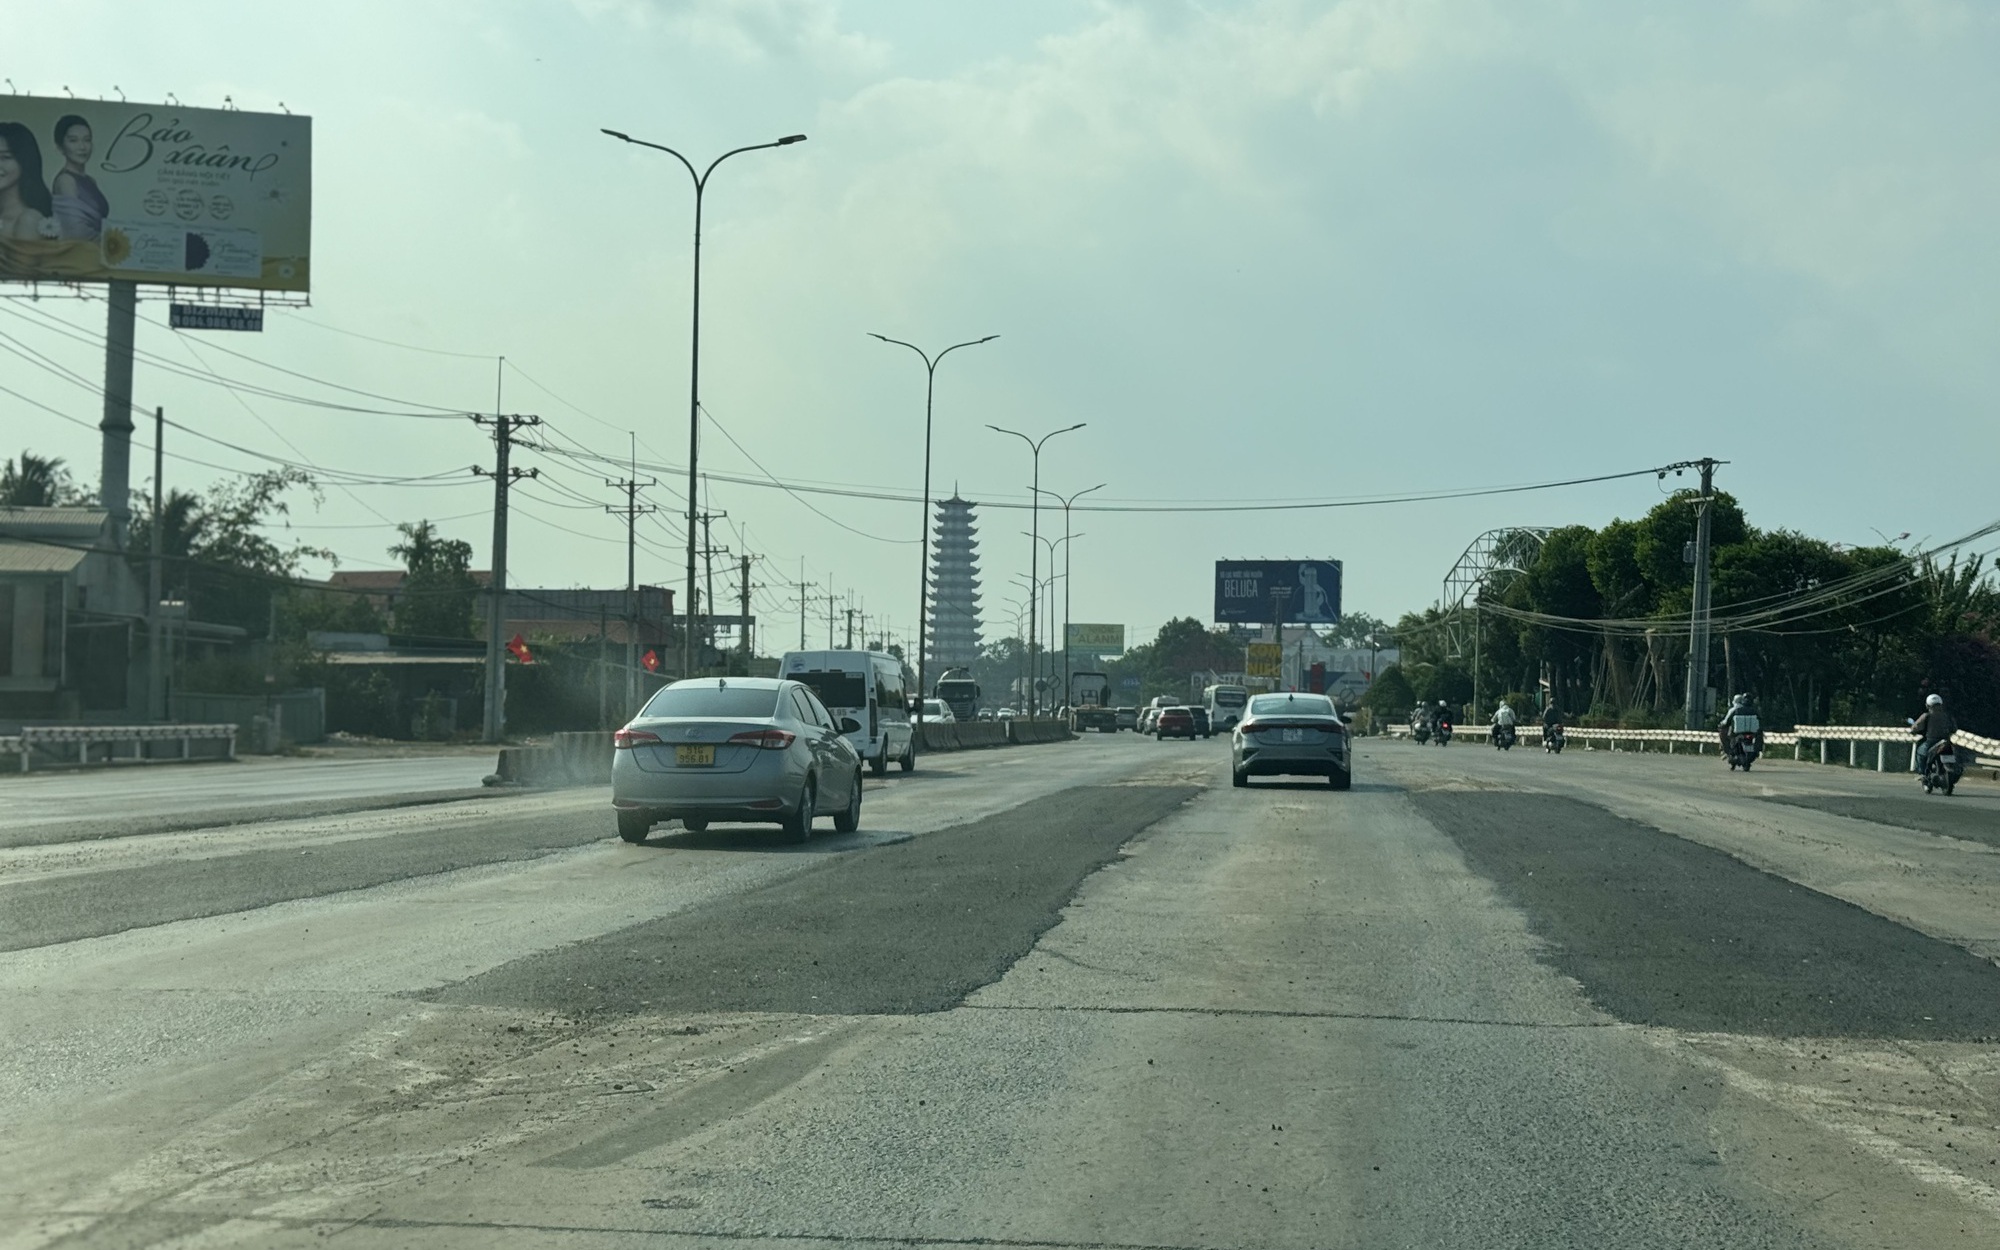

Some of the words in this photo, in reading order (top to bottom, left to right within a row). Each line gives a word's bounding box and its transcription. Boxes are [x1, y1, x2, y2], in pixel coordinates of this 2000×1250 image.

[100, 112, 194, 173] Bảo
[163, 145, 279, 182] xuân
[1224, 579, 1259, 598] BELUGA
